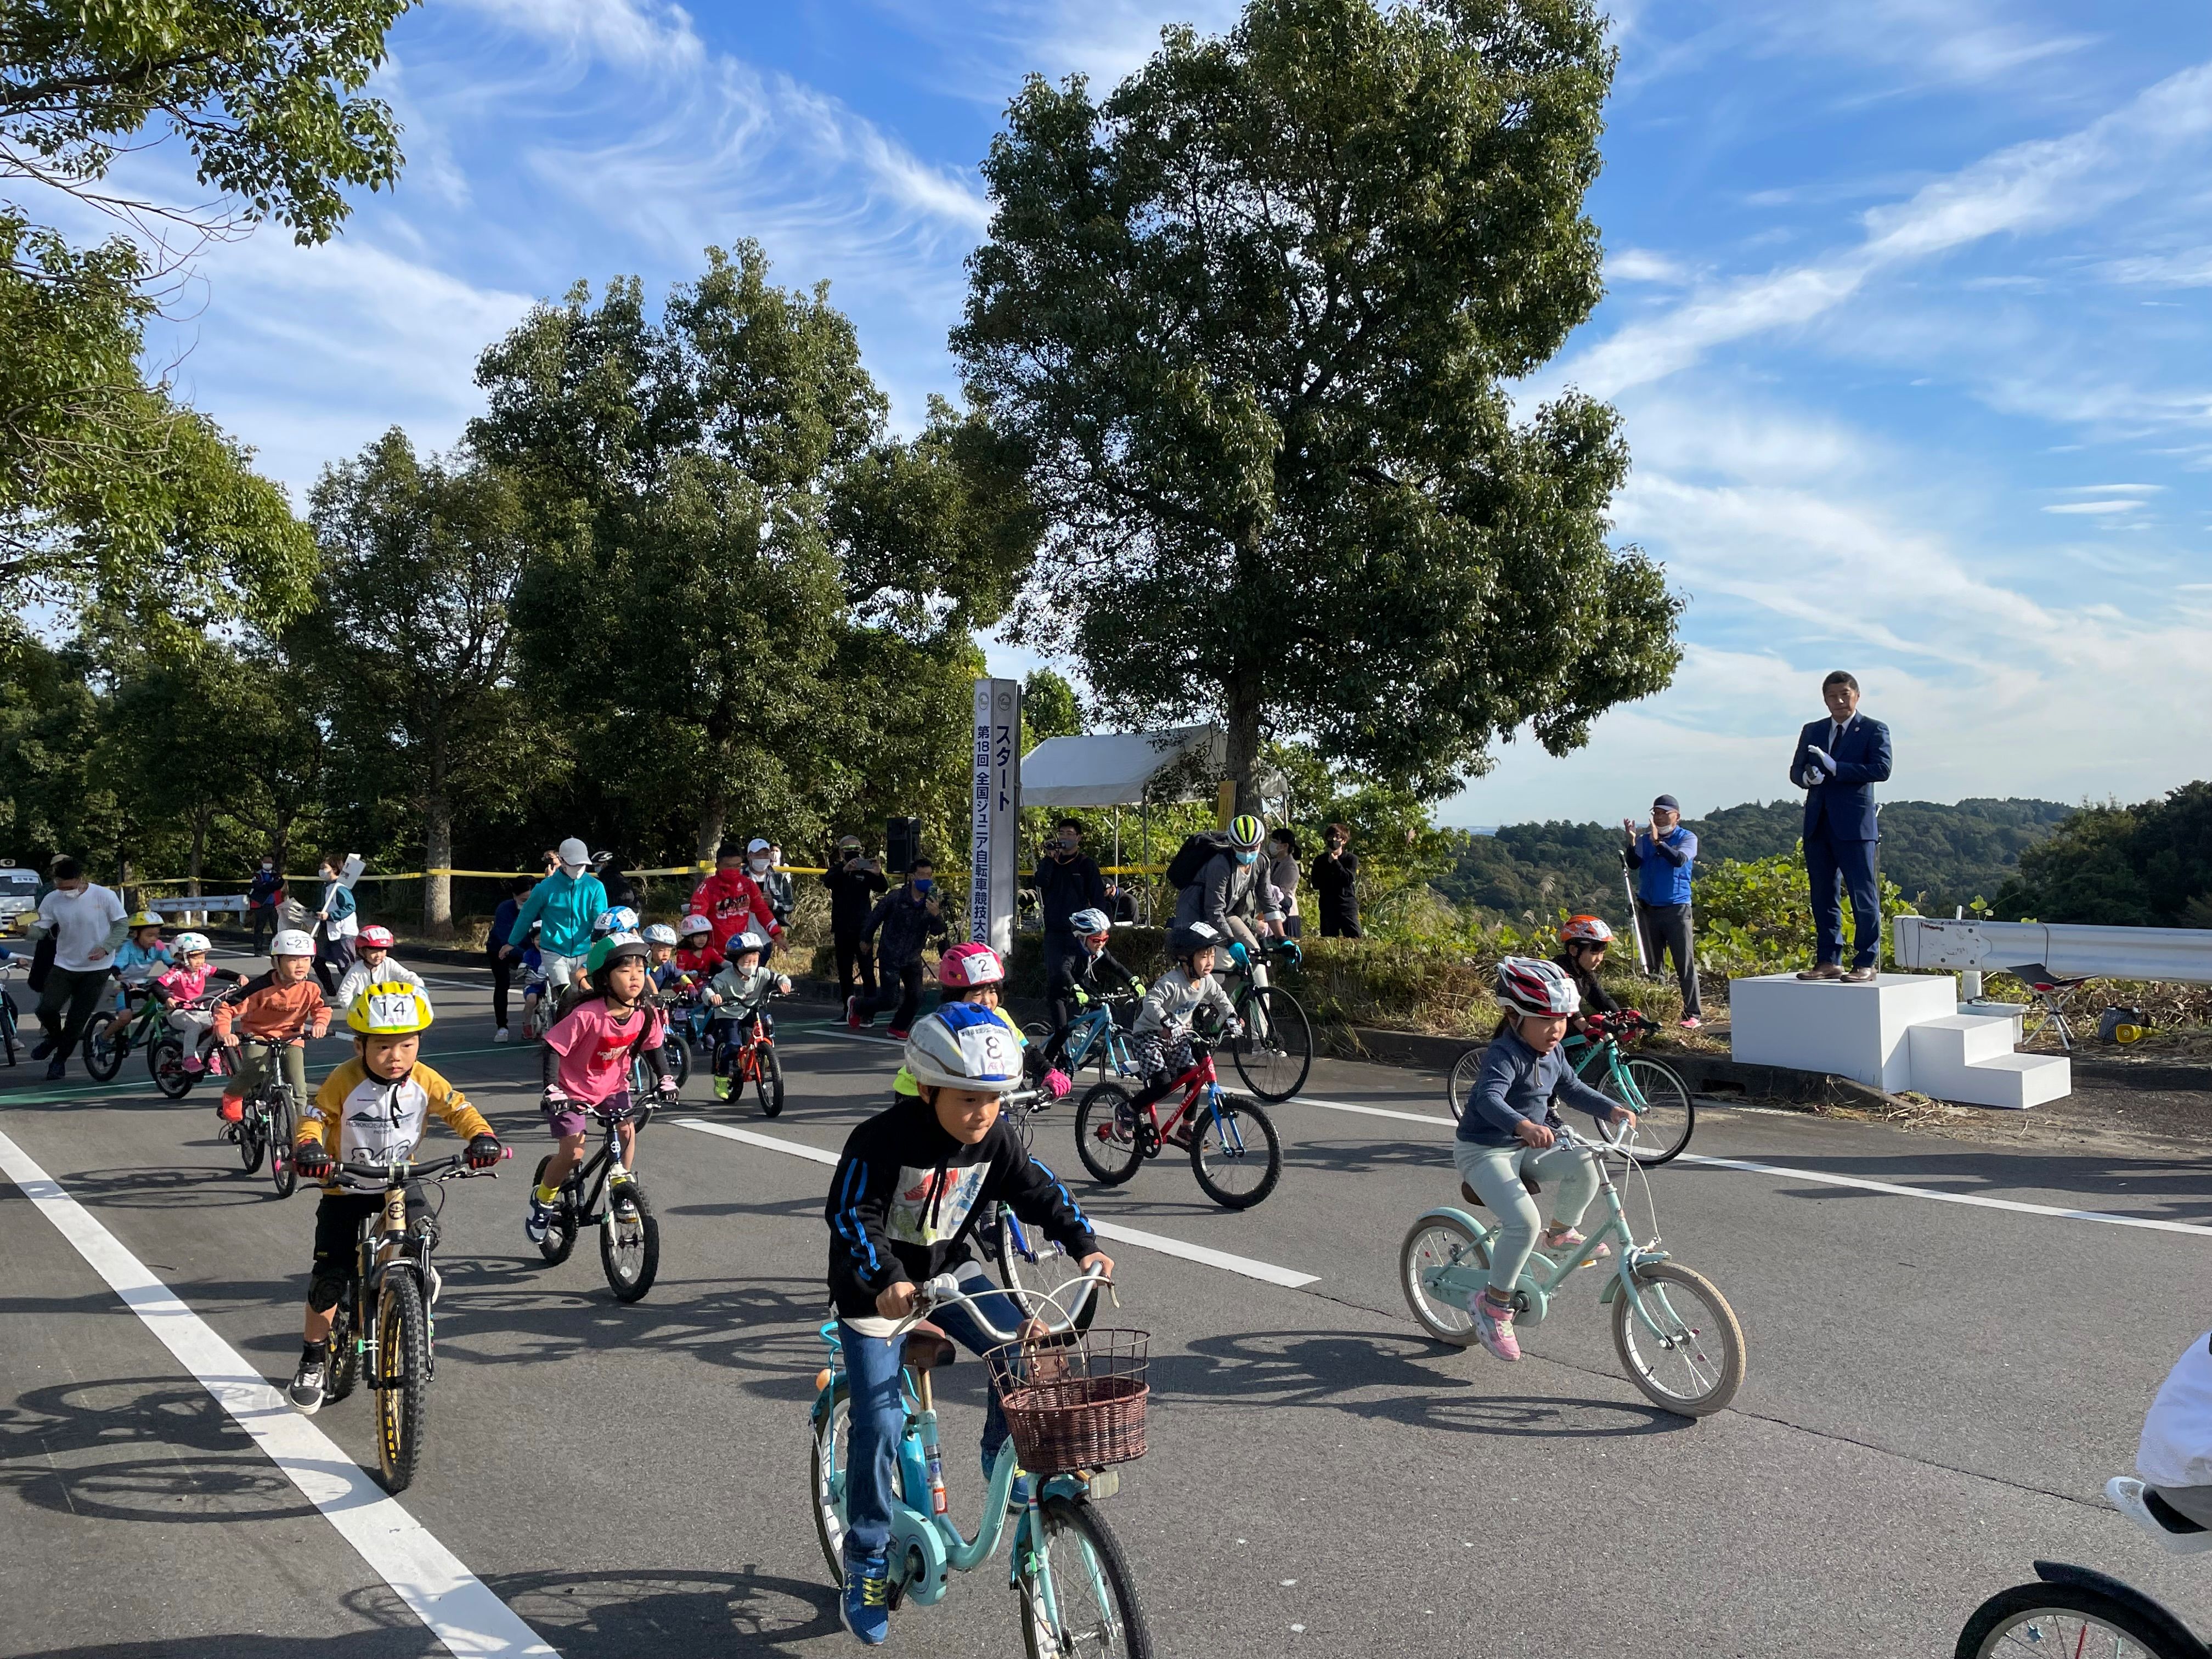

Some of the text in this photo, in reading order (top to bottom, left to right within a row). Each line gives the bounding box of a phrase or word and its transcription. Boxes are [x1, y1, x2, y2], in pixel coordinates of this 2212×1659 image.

[977, 725, 990, 767] 第18回
[996, 725, 1011, 811] スタート
[295, 939, 309, 948] 23
[978, 960, 990, 972] 2
[380, 1001, 406, 1016] 14
[986, 1036, 1002, 1059] 8
